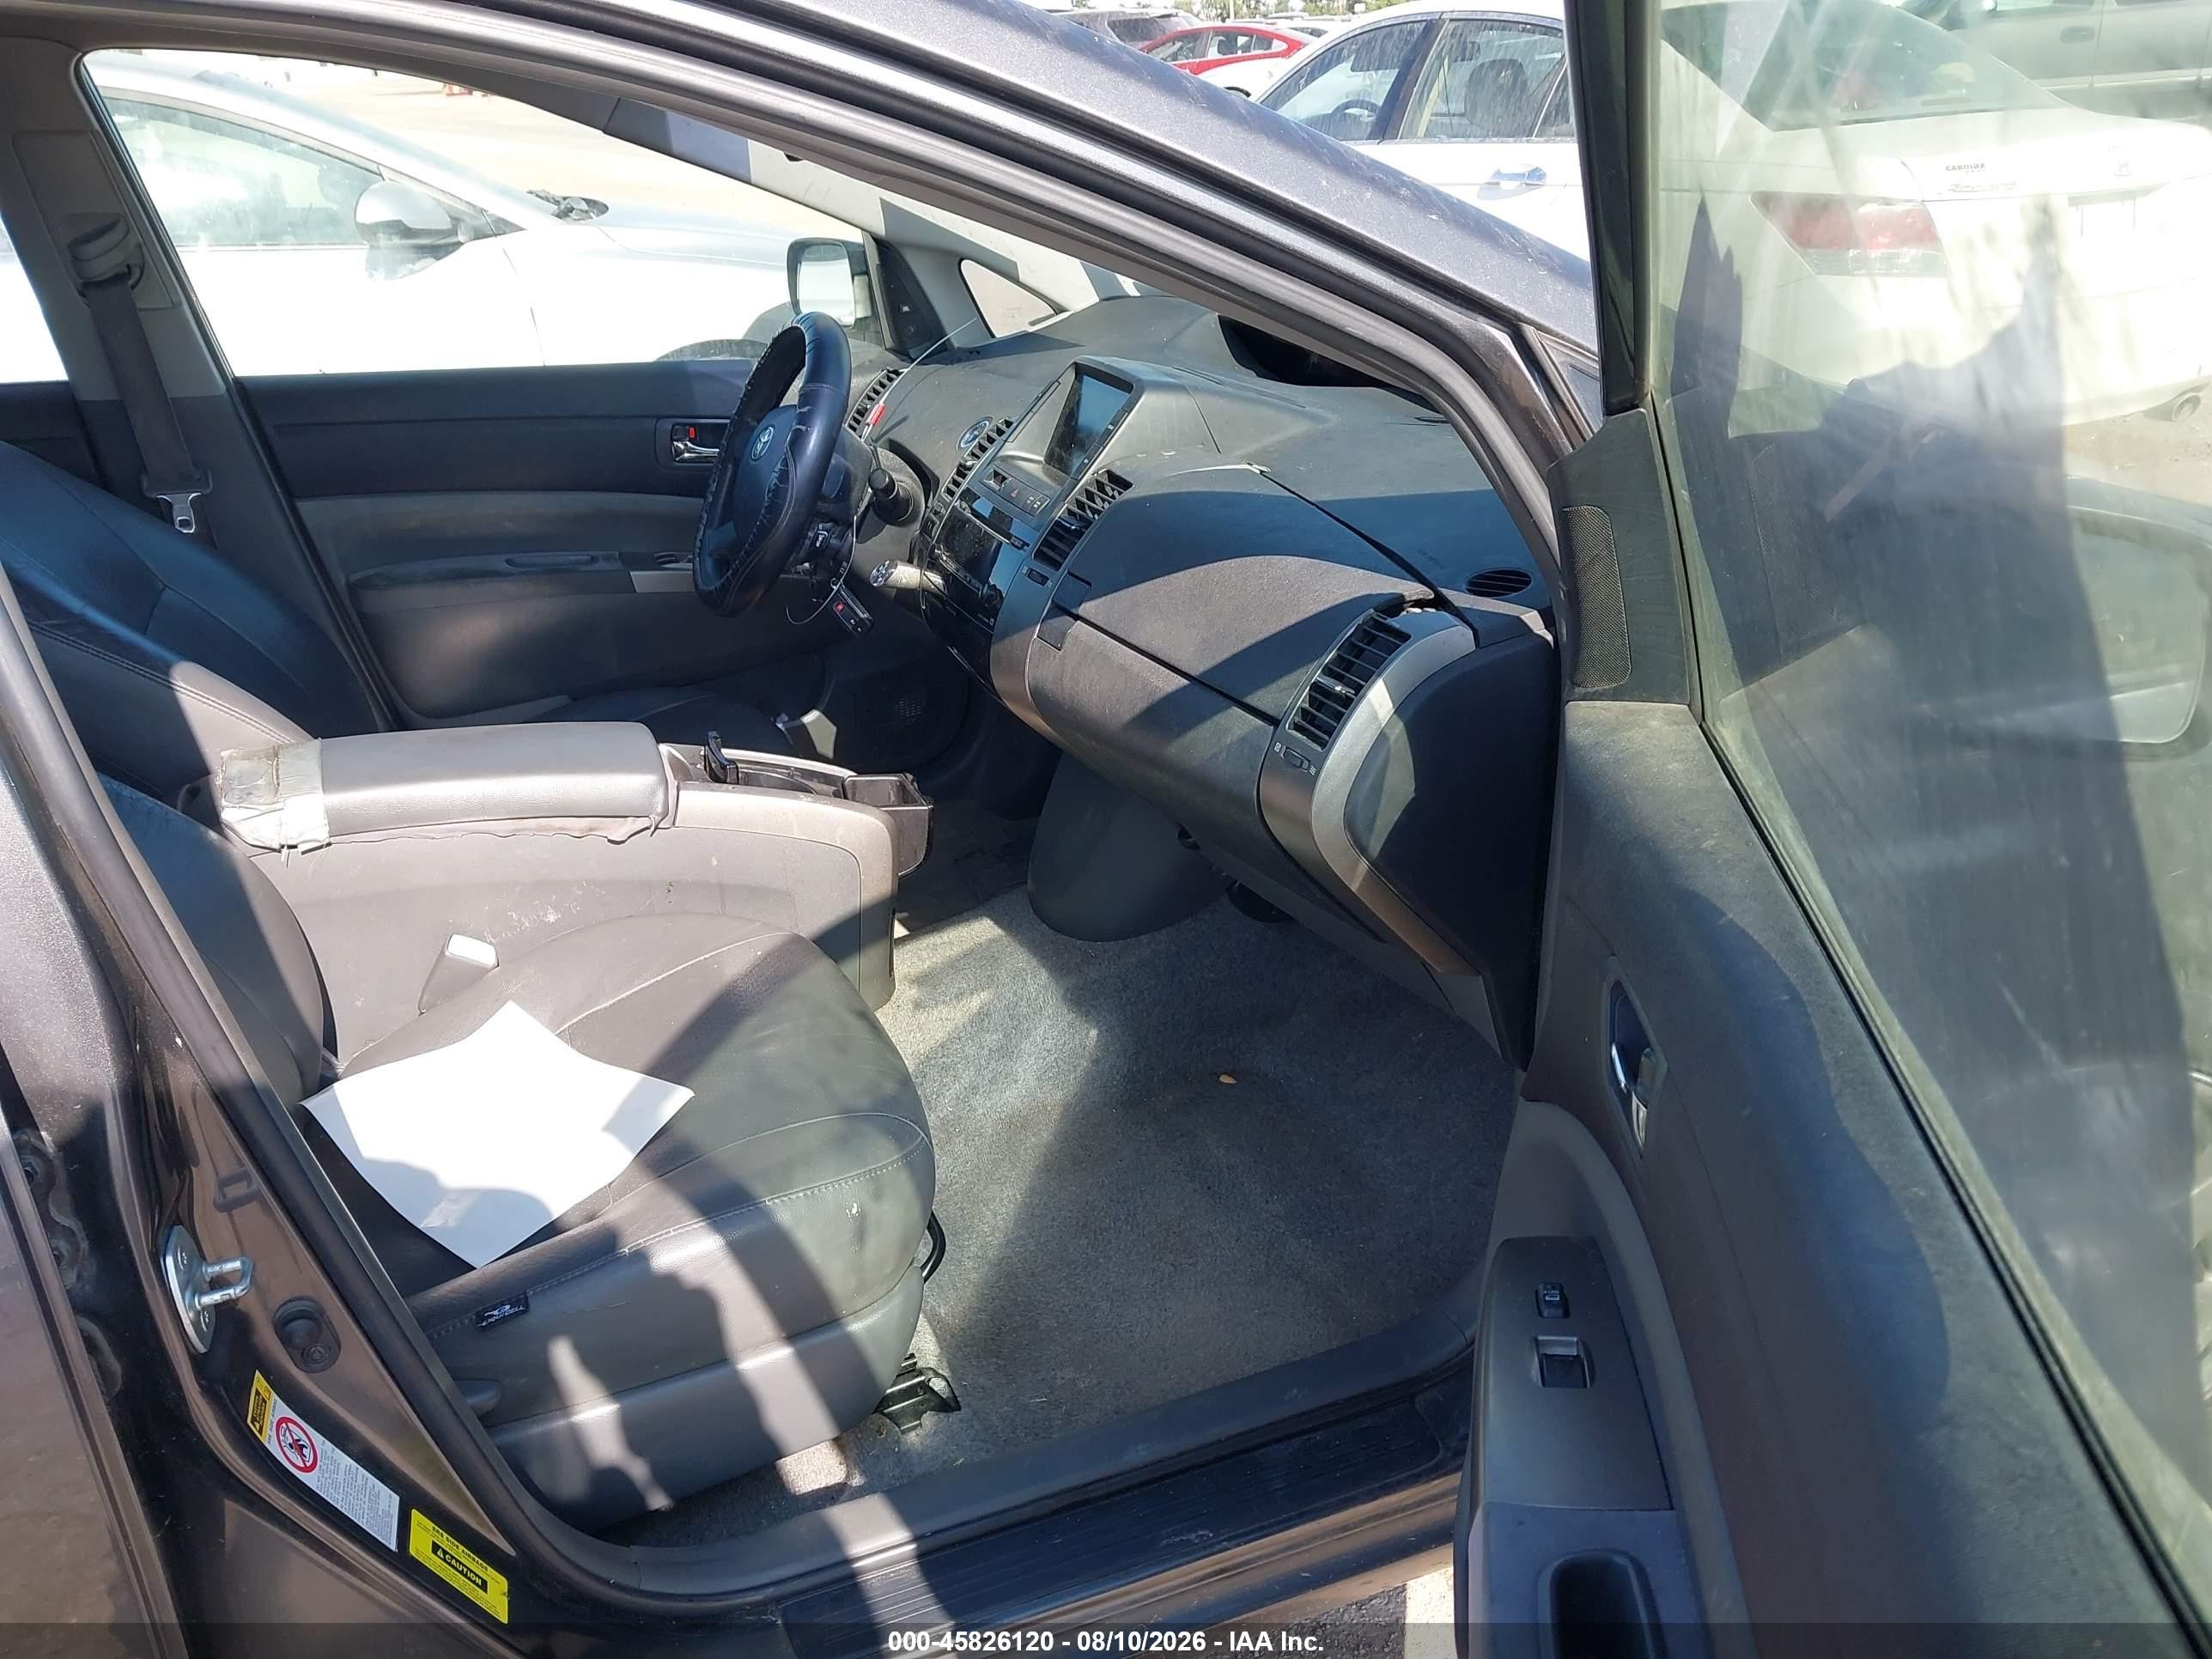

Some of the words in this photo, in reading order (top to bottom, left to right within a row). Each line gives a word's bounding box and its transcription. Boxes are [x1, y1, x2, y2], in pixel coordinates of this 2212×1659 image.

[432, 1525, 445, 1539] SRS
[446, 1535, 459, 1551] SIDE
[445, 1553, 483, 1586] CAUTION
